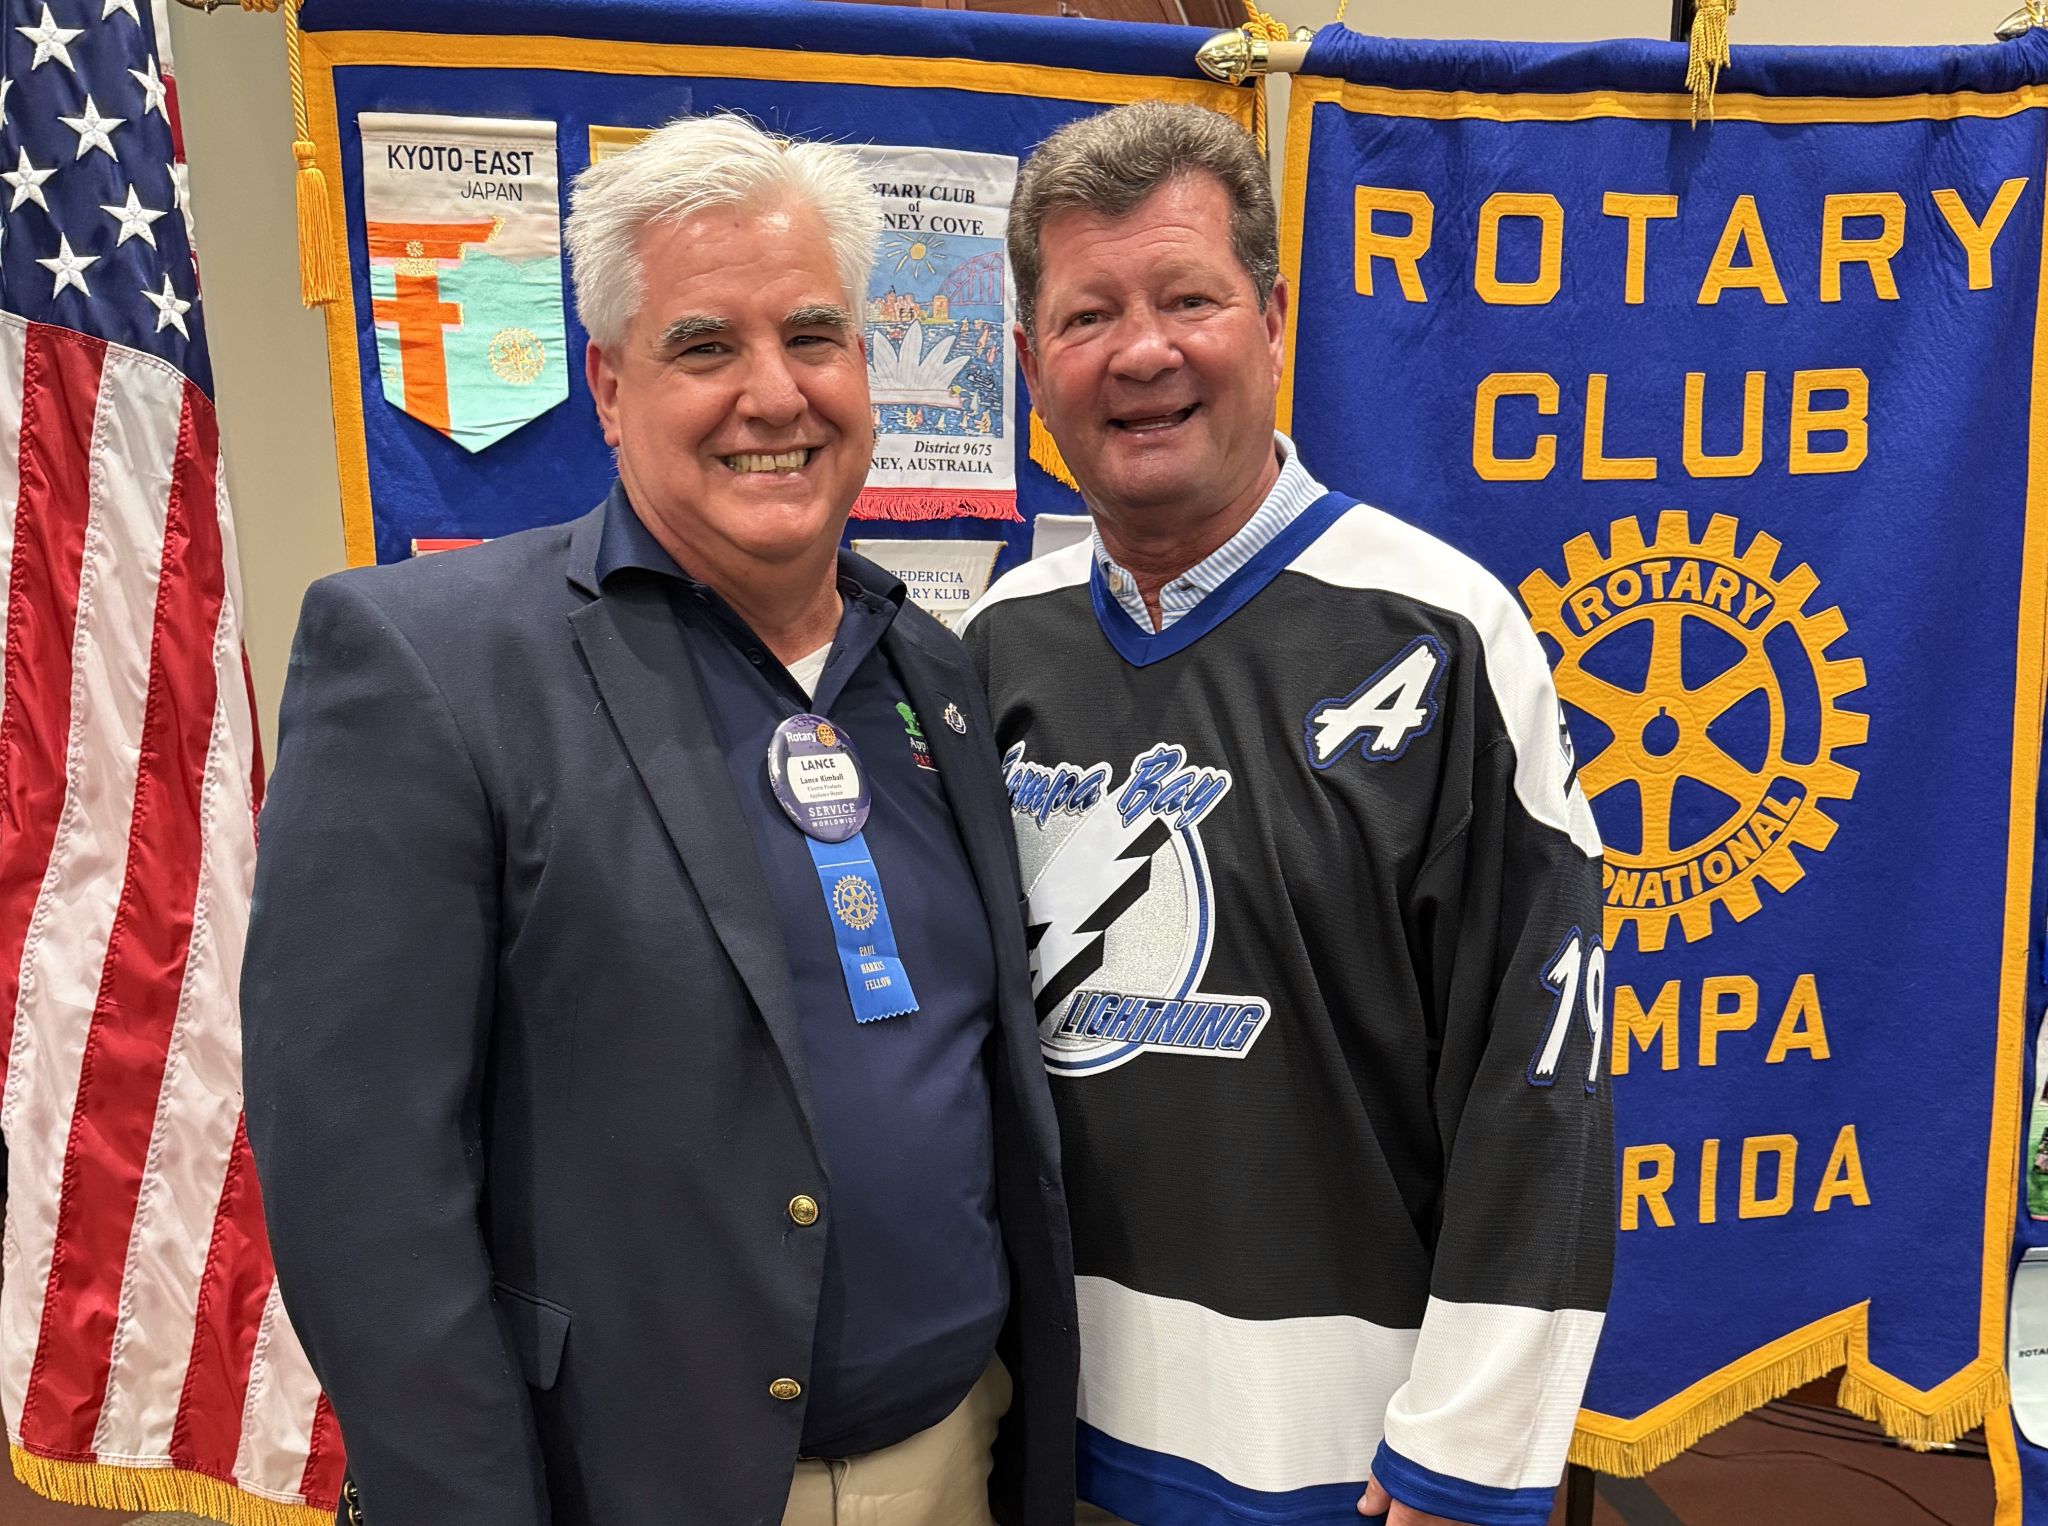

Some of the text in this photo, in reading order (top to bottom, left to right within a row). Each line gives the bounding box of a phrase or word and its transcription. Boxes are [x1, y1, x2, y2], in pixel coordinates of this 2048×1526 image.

[387, 144, 534, 176] KYOTO-EAST
[460, 180, 523, 202] JAPAN
[929, 186, 976, 204] CLUB
[908, 201, 921, 212] of
[930, 216, 985, 236] COVE
[1354, 177, 2029, 305] ROTARY
[1472, 367, 1869, 481] CLUB
[914, 440, 993, 456] District 9675
[907, 458, 993, 474] AUSTRALIA
[934, 588, 970, 600] KLUB
[1568, 559, 1773, 632] ROTARY
[1310, 640, 1441, 765] A
[785, 731, 817, 743] Rotary
[801, 758, 836, 771] LANCE
[799, 773, 844, 785] Lance Kimball
[1117, 746, 1227, 830] Bay
[808, 802, 857, 818] SERVICE
[812, 817, 858, 828] WORLDWIDE
[859, 944, 877, 957] PAUL
[860, 960, 887, 975] HARRIS
[864, 976, 892, 991] FELLOW
[1057, 990, 1266, 1052] LIGHTNING
